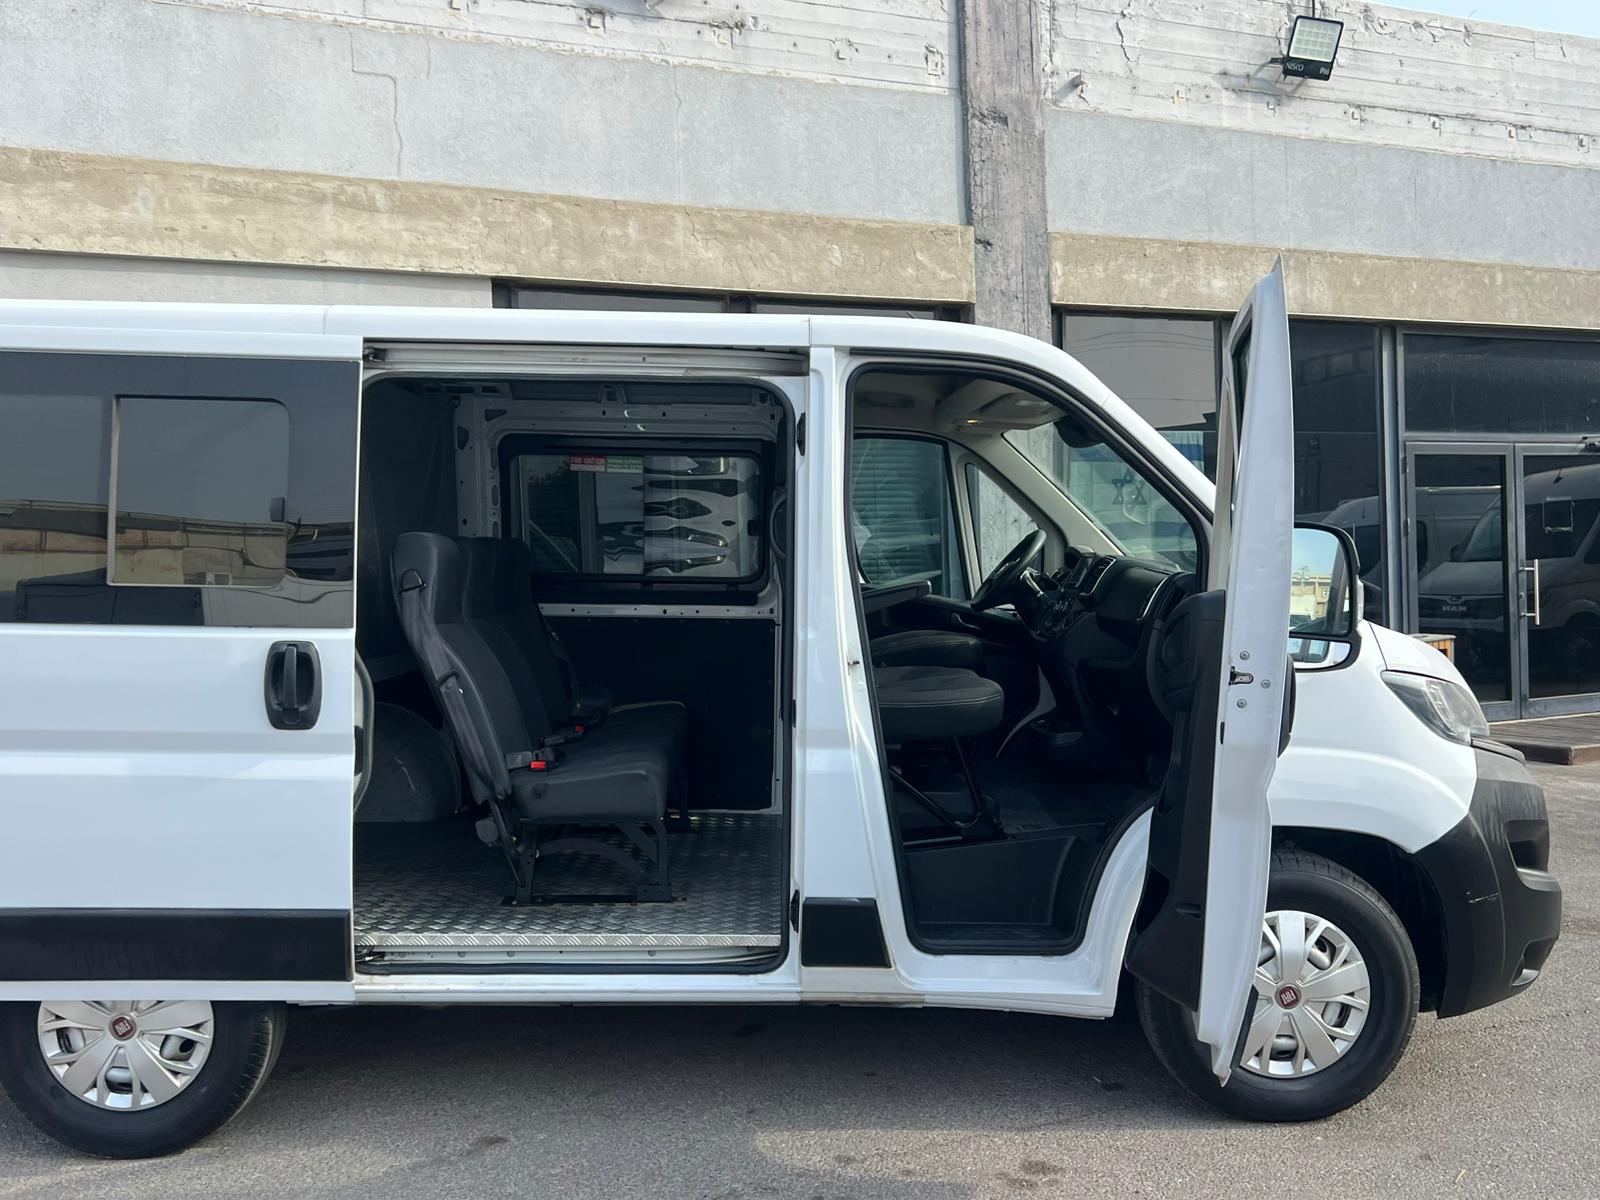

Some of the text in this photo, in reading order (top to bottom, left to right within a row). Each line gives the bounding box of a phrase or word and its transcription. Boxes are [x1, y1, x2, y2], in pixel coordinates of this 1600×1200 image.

[1286, 62, 1304, 72] NISCO
[1280, 989, 1296, 1005] FIAT
[114, 1019, 132, 1036] FIAT
